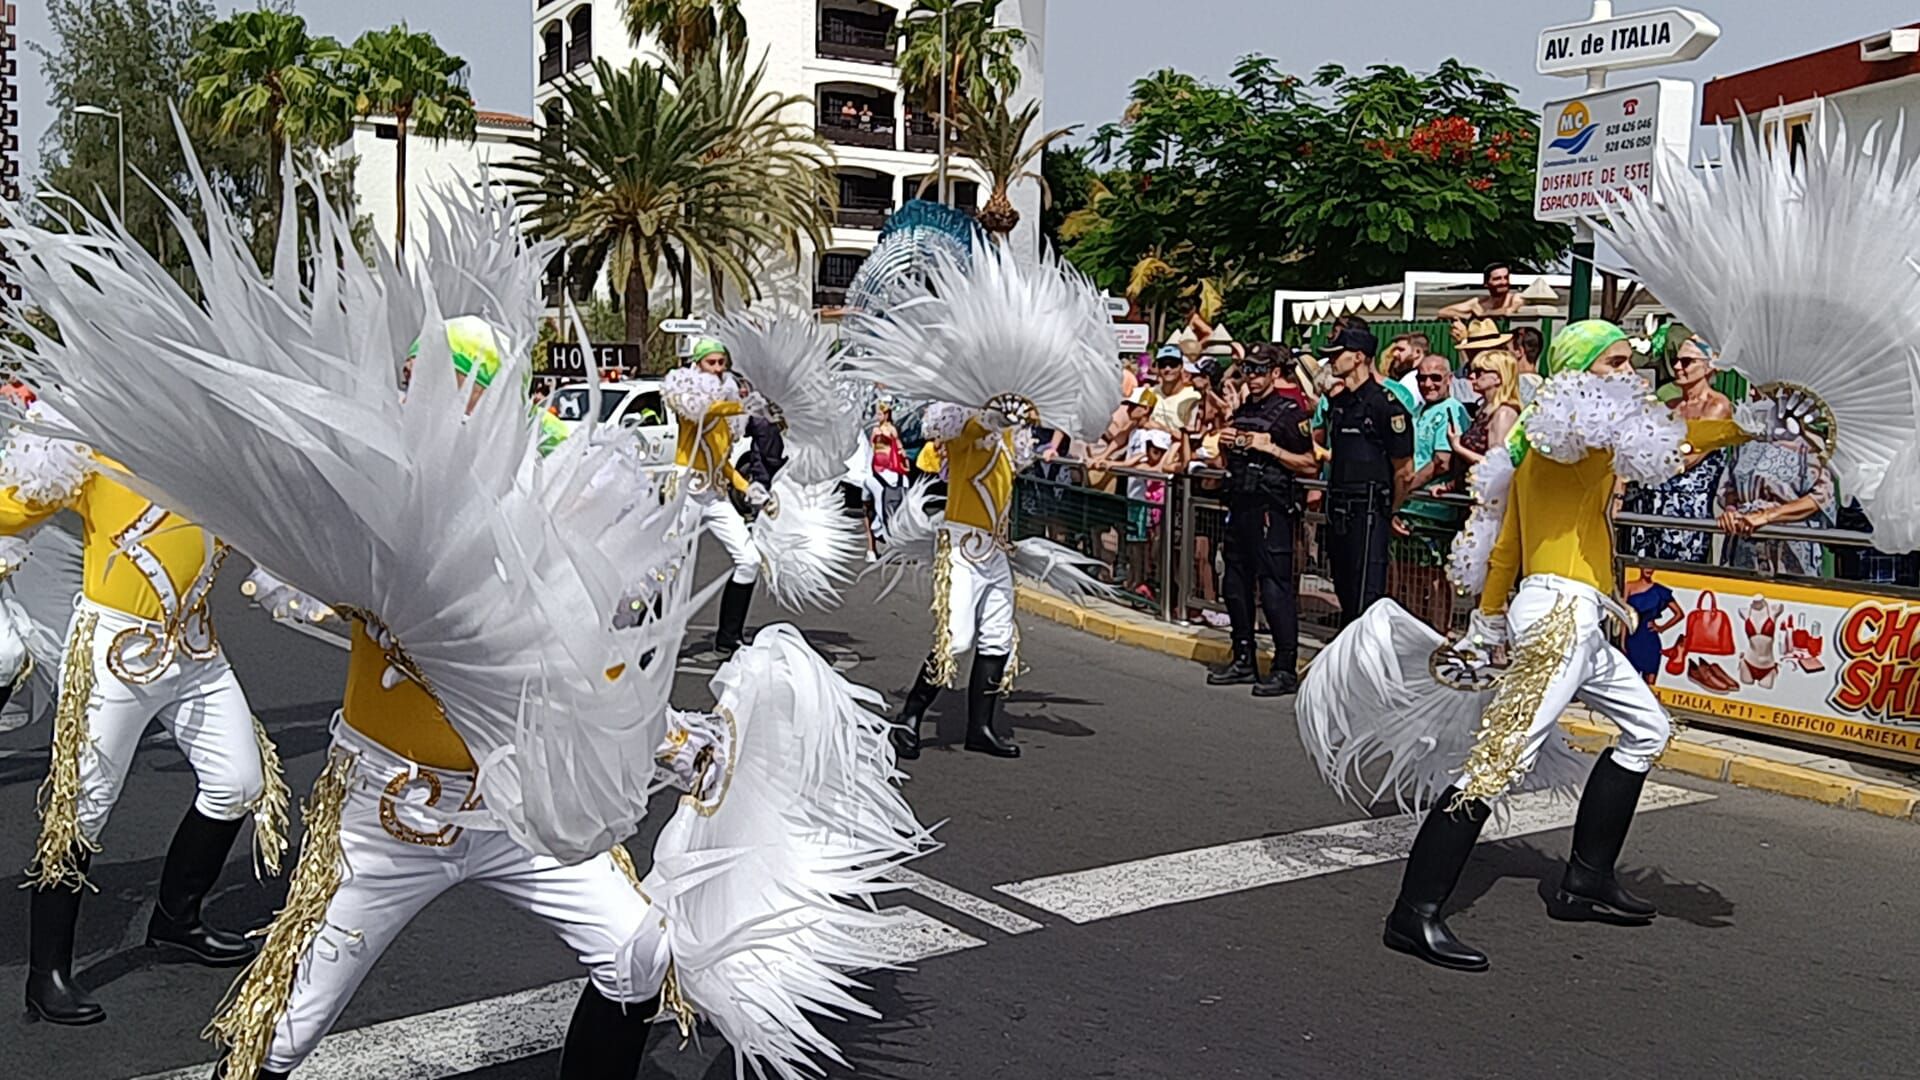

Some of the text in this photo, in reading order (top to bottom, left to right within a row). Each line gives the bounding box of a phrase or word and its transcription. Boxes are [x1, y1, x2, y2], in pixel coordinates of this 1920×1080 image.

[1545, 22, 1670, 60] AV. de ITALIA
[1561, 112, 1584, 131] MC
[1605, 123, 1620, 136] 928
[1621, 120, 1636, 132] 426
[1604, 140, 1620, 153] 928
[1620, 138, 1635, 149] 426
[1542, 162, 1650, 191] DISFRUTE DE ESTE
[1540, 193, 1579, 211] ESPACIO
[553, 347, 631, 370] HOEL
[1837, 659, 1920, 716] SH
[1672, 694, 1716, 713] ITALIA,
[1772, 711, 1835, 733] EDIFICIO
[1841, 724, 1907, 747] MARIETA
